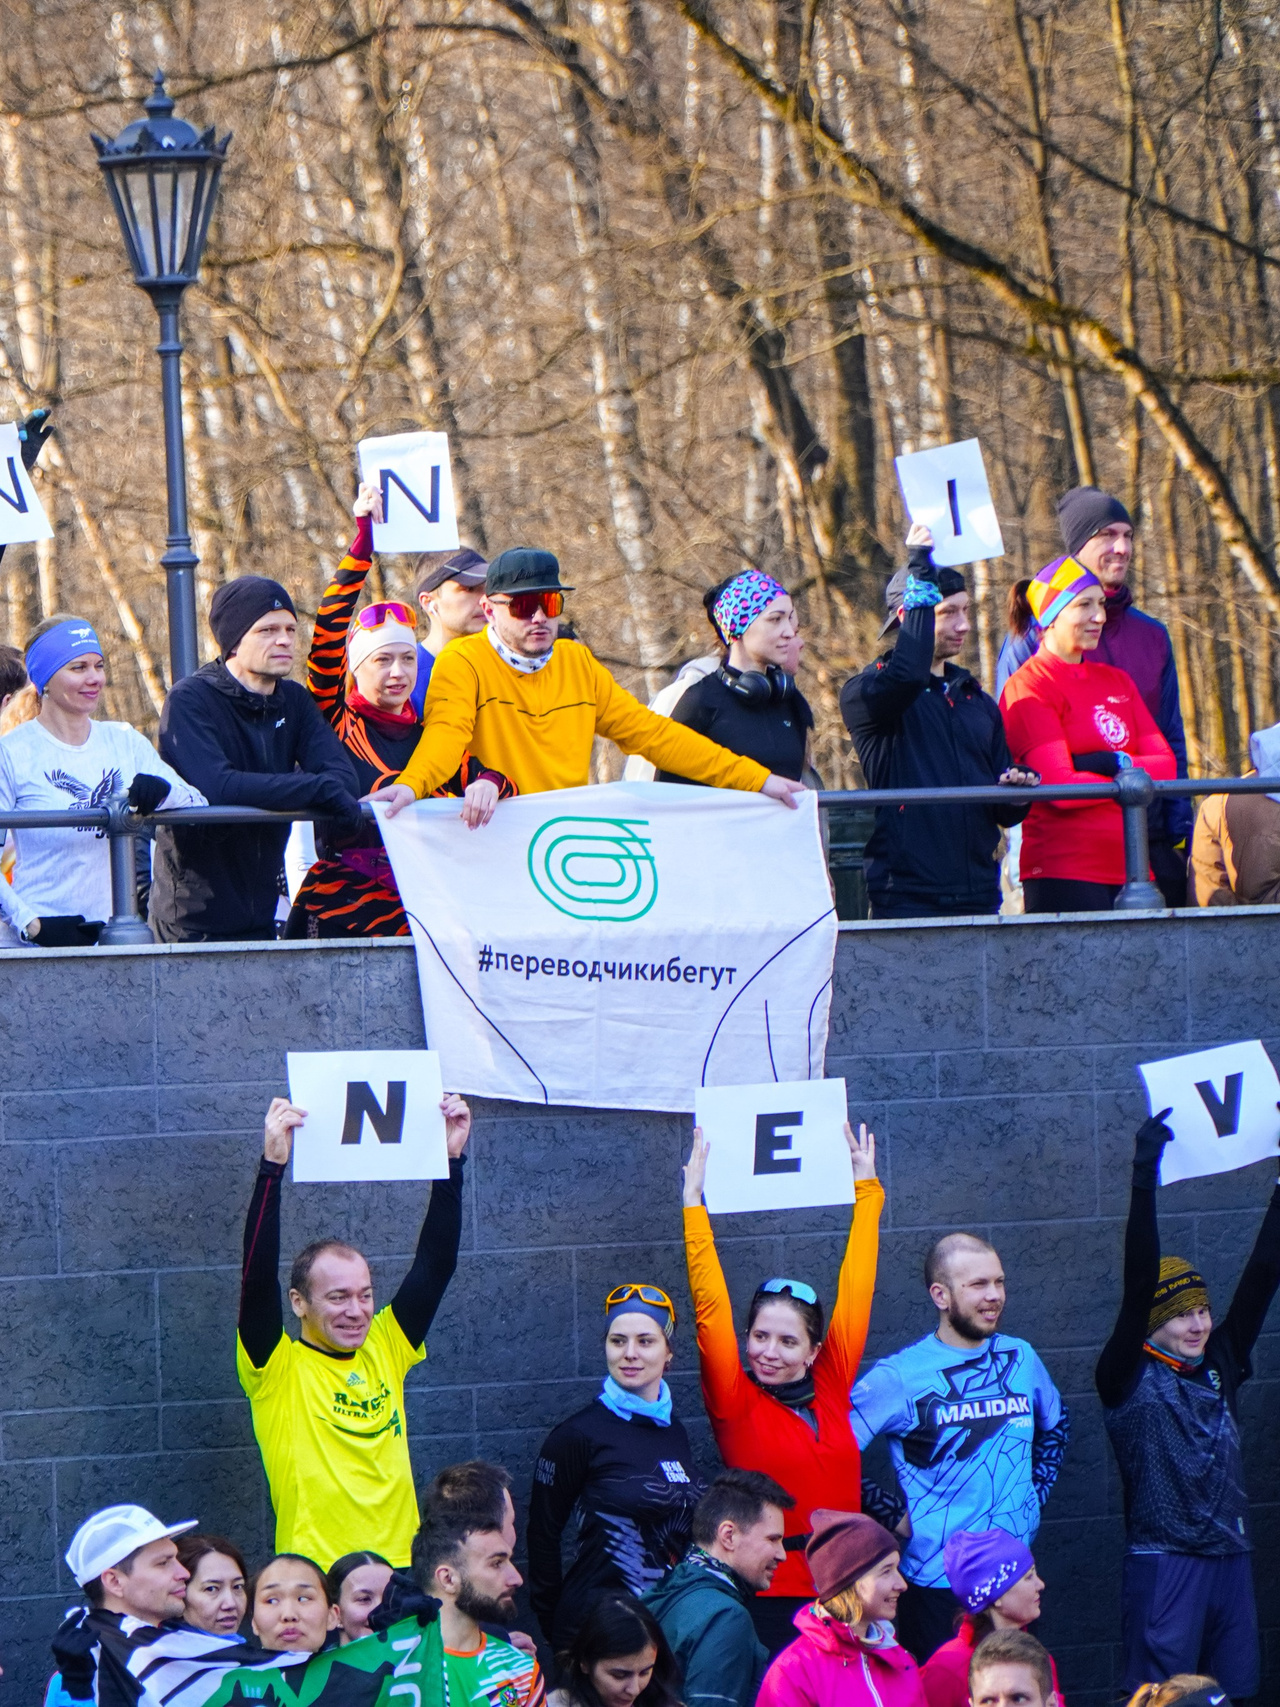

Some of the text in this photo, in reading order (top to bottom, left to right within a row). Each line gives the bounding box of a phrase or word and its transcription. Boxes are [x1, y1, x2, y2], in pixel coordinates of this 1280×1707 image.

[380, 465, 440, 523] N
[947, 478, 962, 537] I
[478, 944, 737, 990] #переводчикибегут
[340, 1081, 407, 1145] N
[1194, 1071, 1244, 1138] V
[753, 1111, 804, 1175] E
[333, 1405, 368, 1418] ULTRA
[936, 1397, 1030, 1426] MALIDAK
